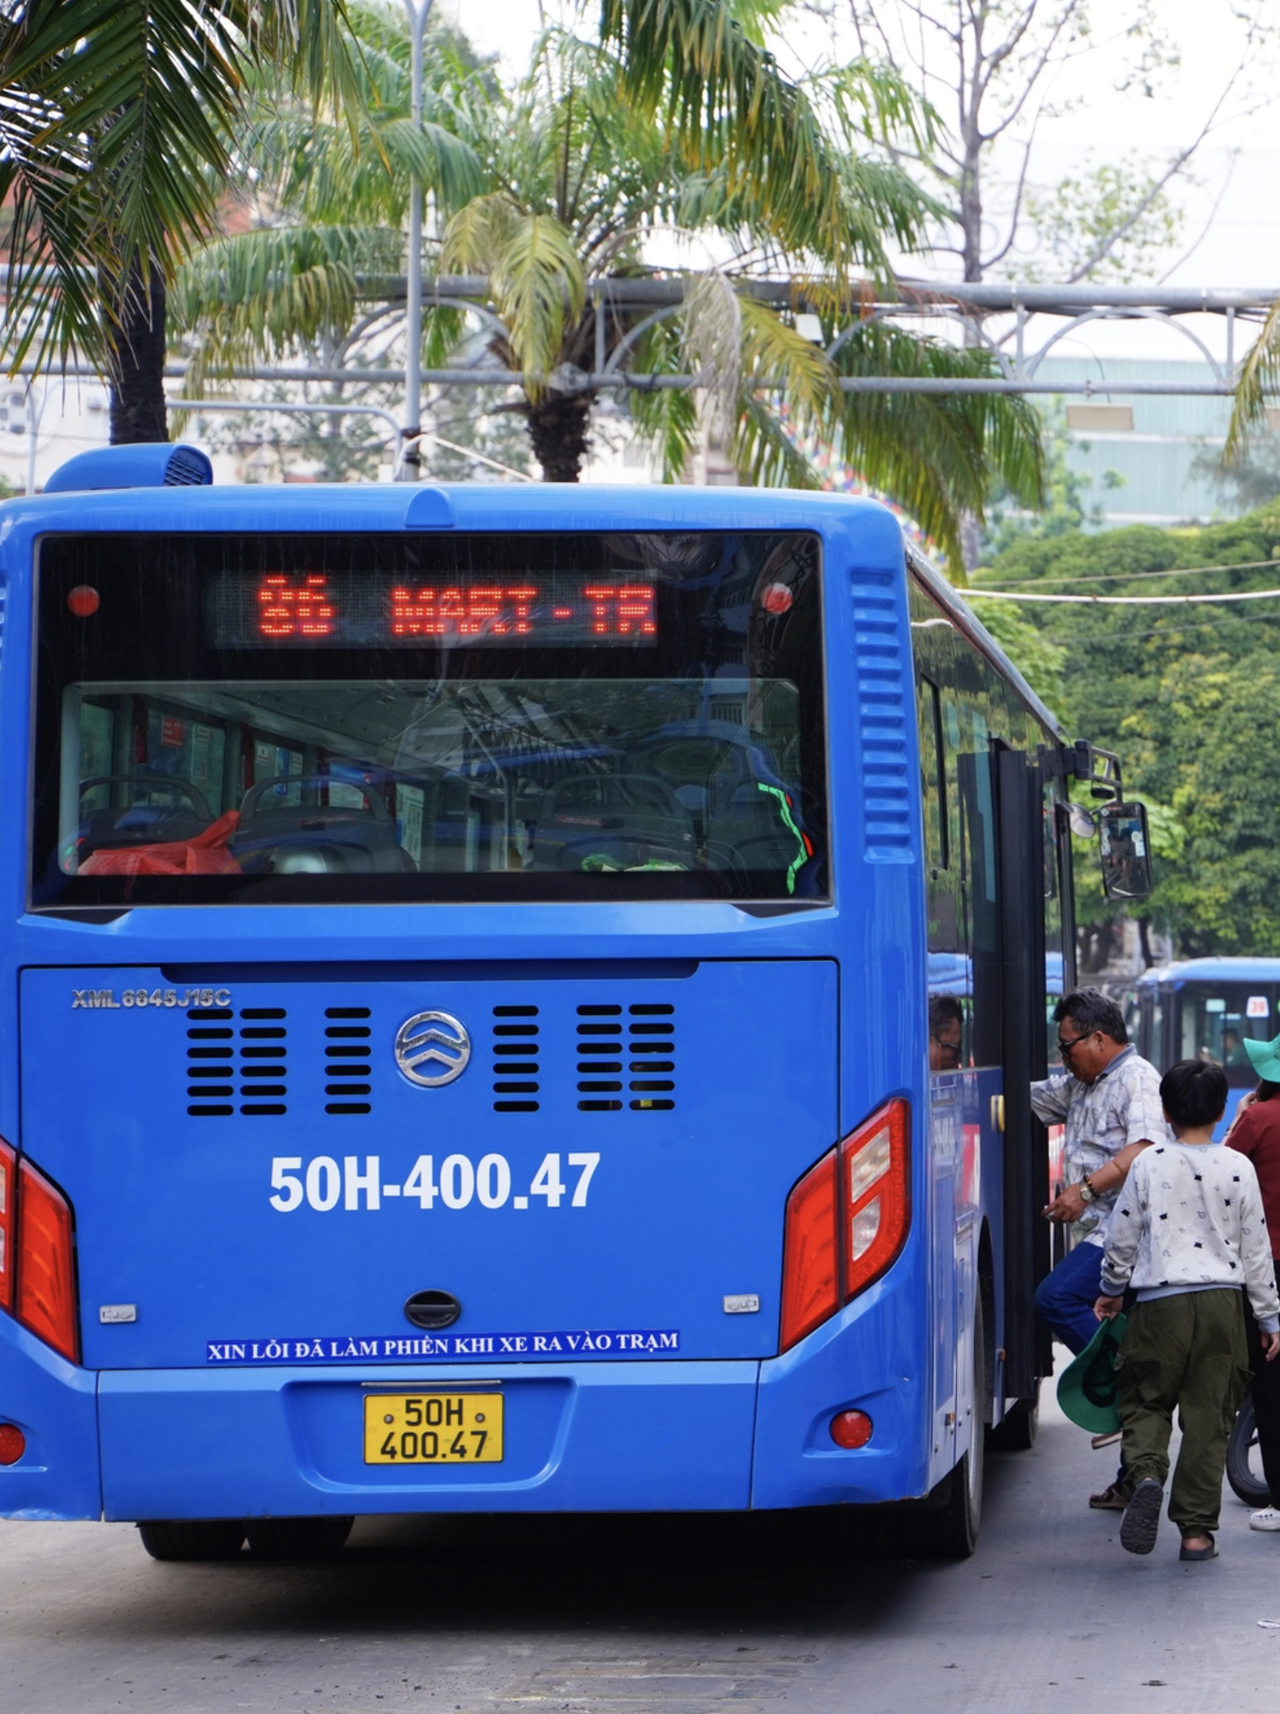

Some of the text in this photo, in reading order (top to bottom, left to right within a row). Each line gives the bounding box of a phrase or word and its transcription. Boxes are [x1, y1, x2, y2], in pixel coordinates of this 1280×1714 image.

[257, 574, 334, 636] 86
[393, 584, 538, 636] MART
[1250, 1001, 1266, 1013] 39
[269, 1152, 601, 1213] 50H-400.47
[207, 1344, 246, 1360] XIN
[251, 1338, 290, 1359] LỖI
[294, 1338, 325, 1359] ĐÃ
[330, 1337, 378, 1358] LÀM
[454, 1337, 494, 1354] KHI
[499, 1336, 528, 1353] XE
[533, 1335, 562, 1352] RA
[566, 1330, 612, 1351] VÀO
[616, 1332, 679, 1353] TRẠM
[405, 1398, 464, 1427] 50H
[380, 1430, 488, 1460] 400.47
